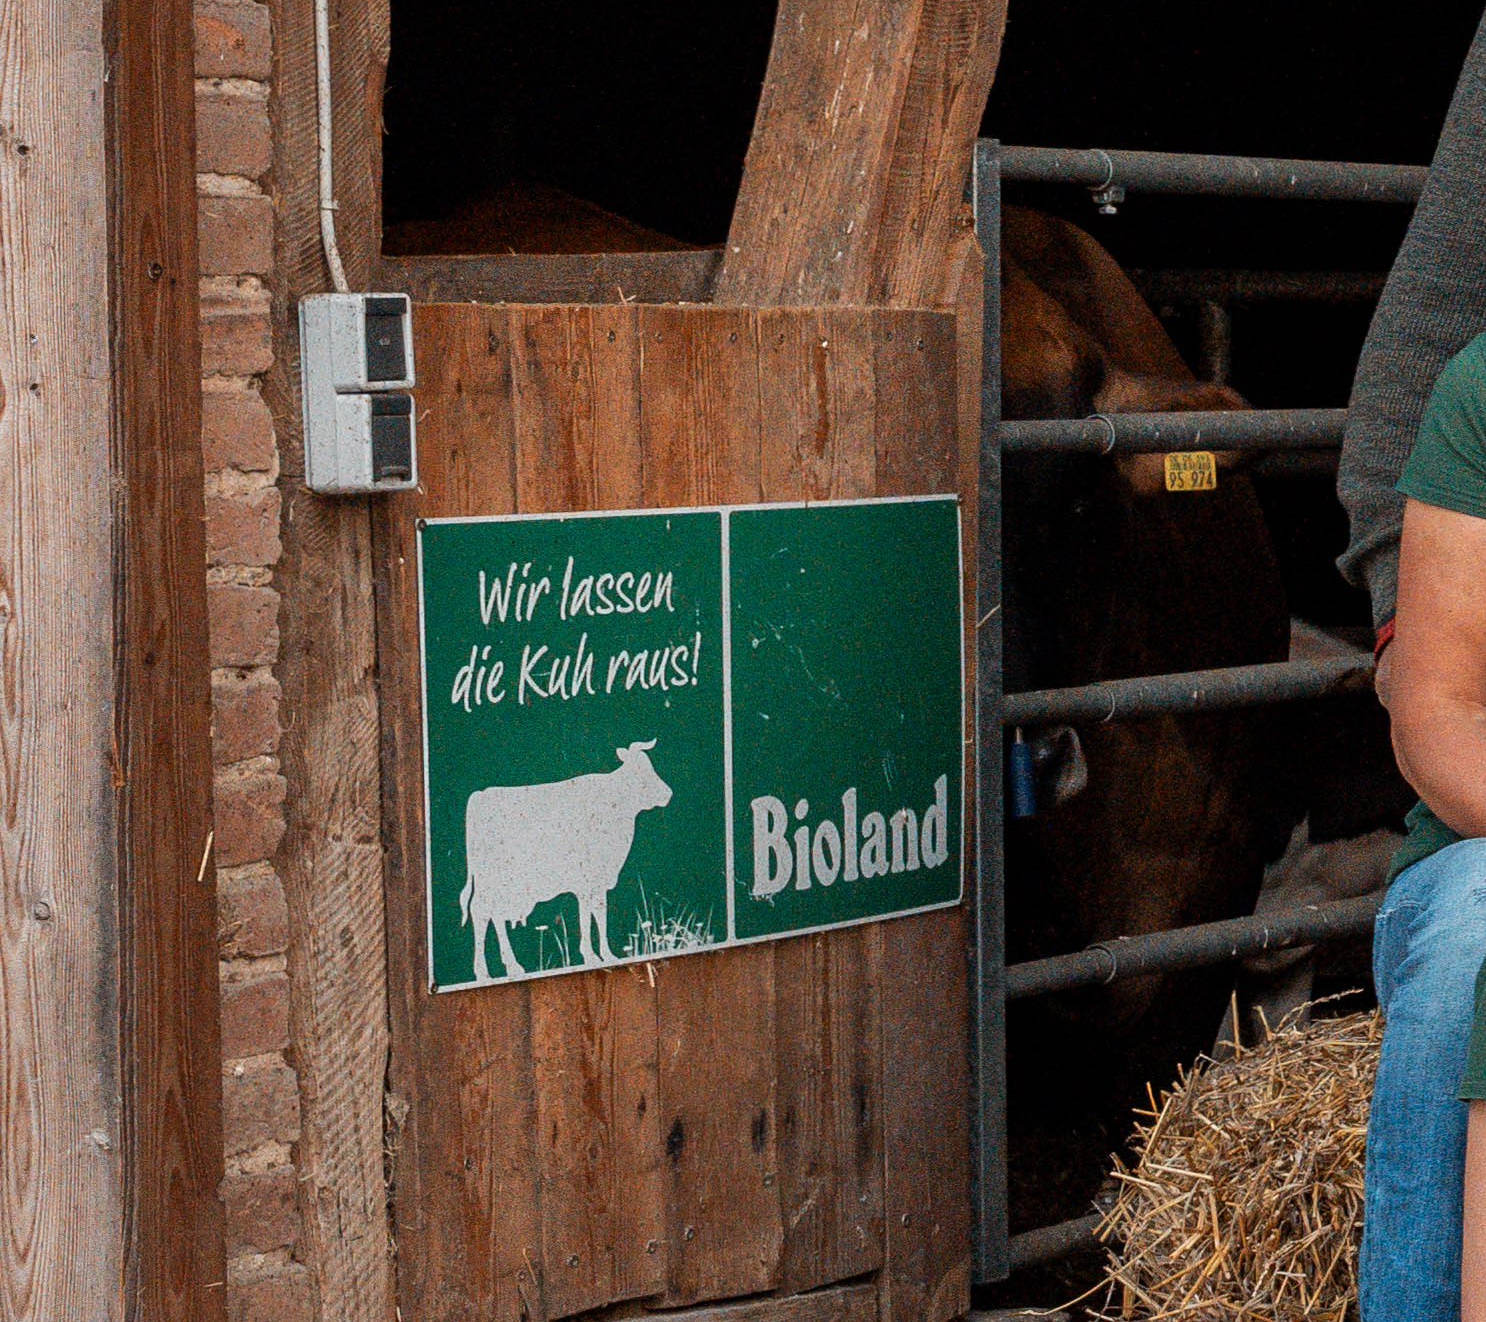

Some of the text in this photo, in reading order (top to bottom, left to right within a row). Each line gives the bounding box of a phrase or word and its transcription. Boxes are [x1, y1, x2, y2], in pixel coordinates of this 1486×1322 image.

[478, 555, 675, 625] Wir lassen
[451, 631, 702, 713] die Kuh raus!
[751, 773, 949, 896] Bioland
